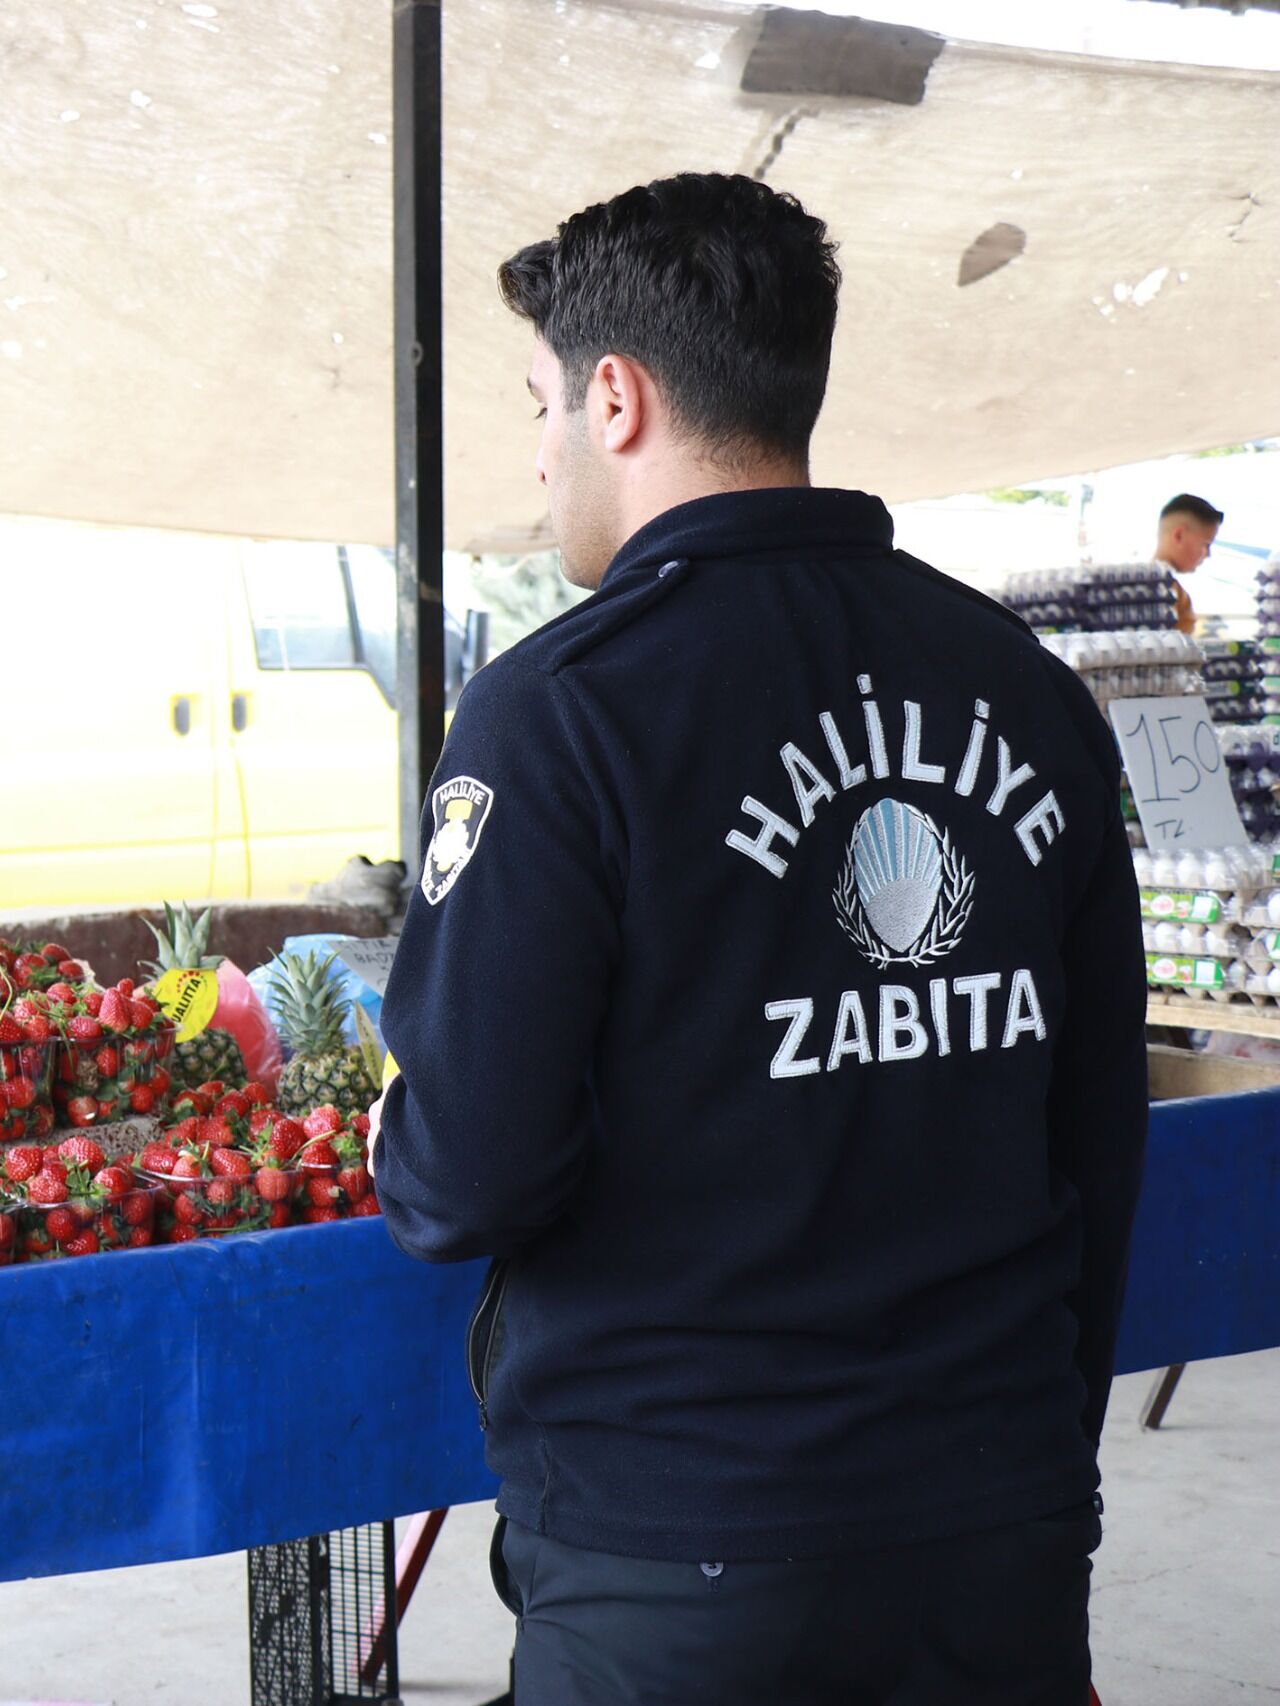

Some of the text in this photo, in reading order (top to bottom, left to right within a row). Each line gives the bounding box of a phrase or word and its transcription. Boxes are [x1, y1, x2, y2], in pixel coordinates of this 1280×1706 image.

[724, 673, 1066, 880] HALİLİYE
[1126, 713, 1220, 802] 150
[1154, 819, 1185, 840] TL
[764, 968, 1047, 1079] ZABITA
